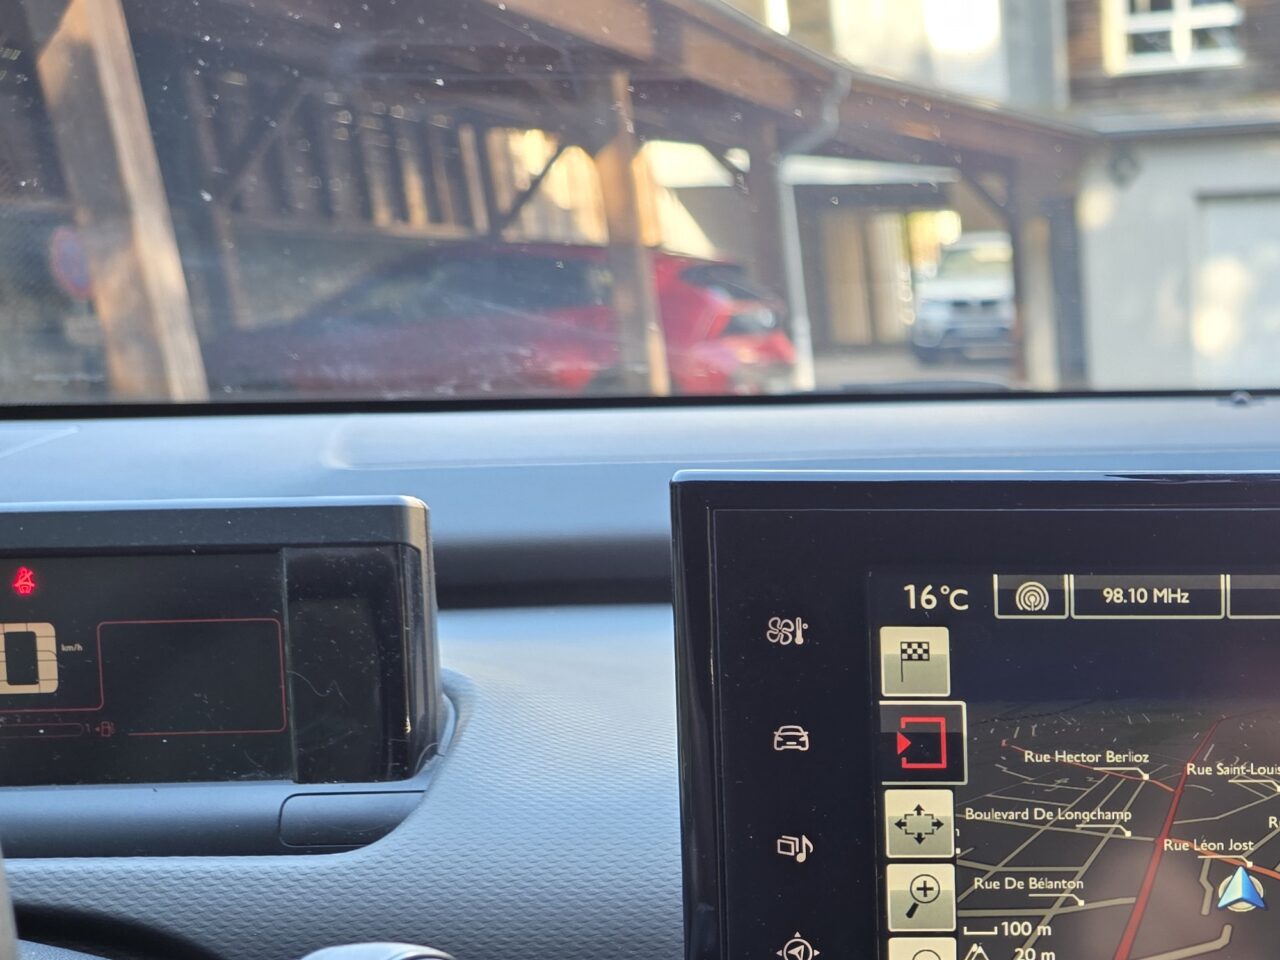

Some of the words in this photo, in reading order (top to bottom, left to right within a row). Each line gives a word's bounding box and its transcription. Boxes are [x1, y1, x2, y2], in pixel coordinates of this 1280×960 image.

[904, 583, 969, 611] 16°C
[1102, 588, 1149, 605] 98.10
[1153, 588, 1190, 605] MHz
[61, 643, 83, 652] km/h
[1024, 750, 1051, 763] Rue
[1055, 750, 1102, 763] Hector
[1106, 750, 1150, 763] Berlioz
[1186, 763, 1213, 776] Rue
[965, 808, 1030, 821] Boulevard
[1034, 808, 1054, 821] De
[1058, 808, 1132, 823] Longchamp
[1163, 839, 1190, 851] Rue
[1193, 838, 1224, 851] Léon
[1228, 839, 1254, 852] Jost
[974, 877, 1000, 890] Rue
[1004, 877, 1025, 890] De
[1028, 876, 1084, 890] Bélanton
[1001, 922, 1033, 936] 100
[1037, 926, 1052, 936] m
